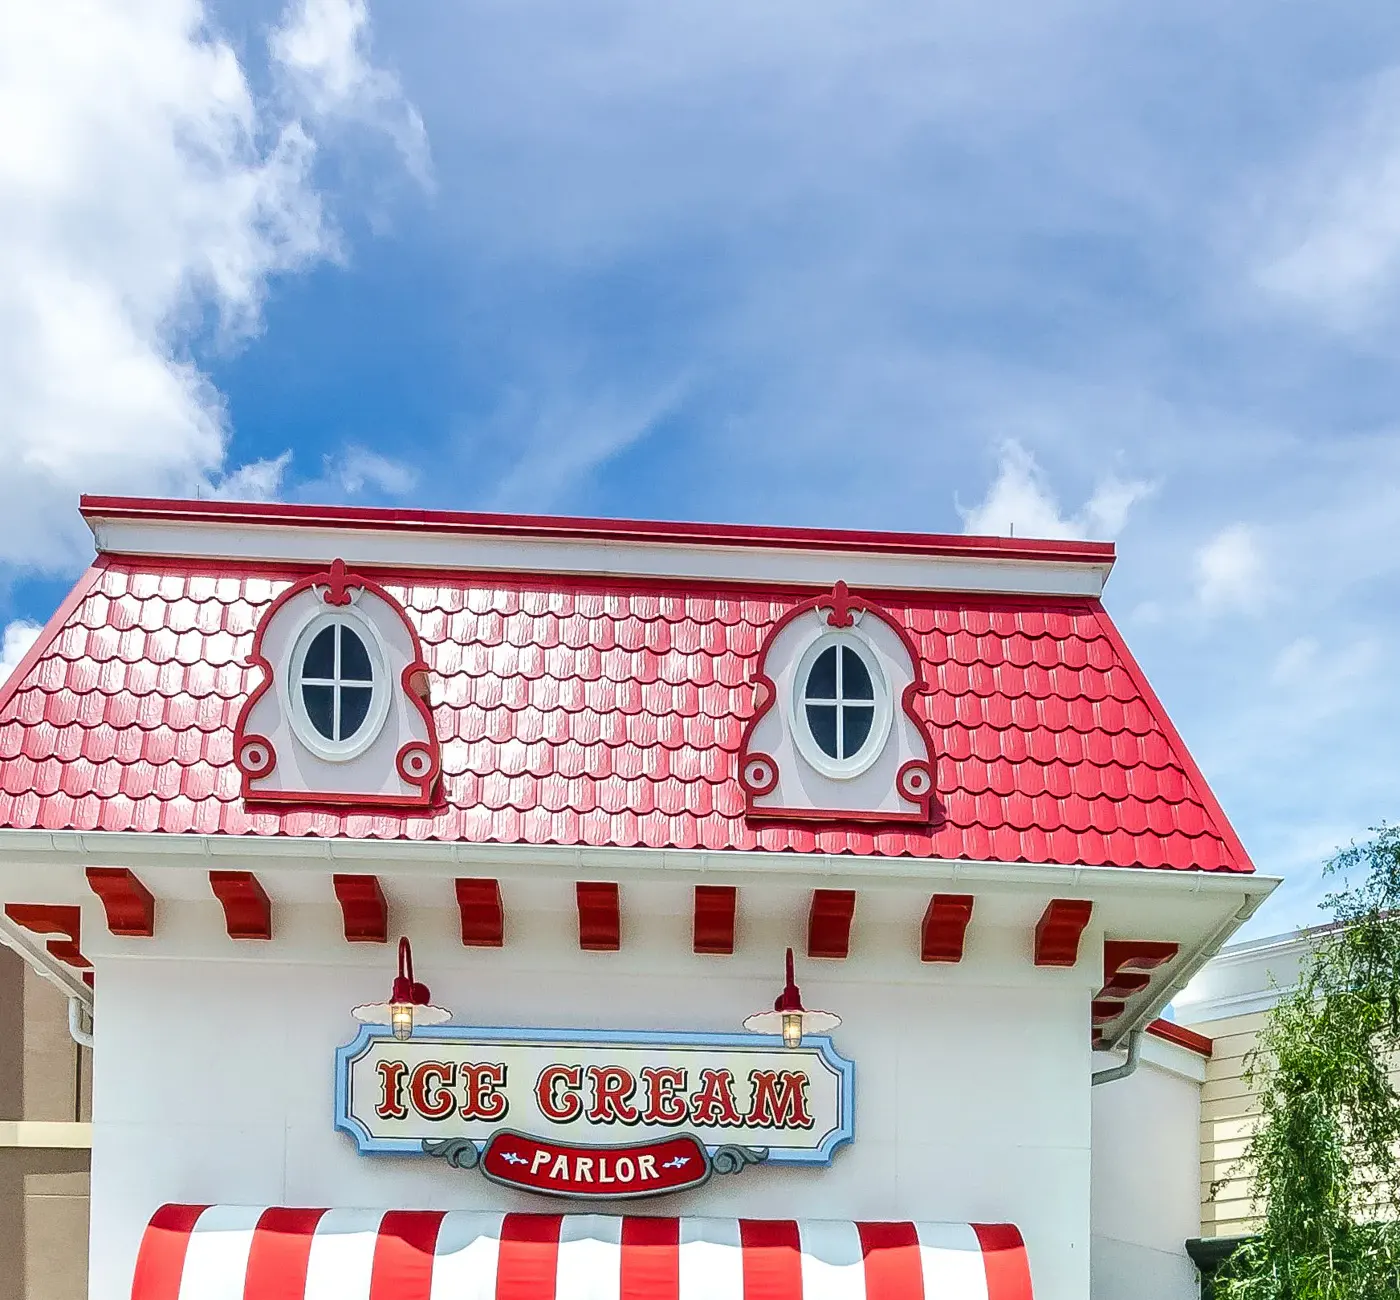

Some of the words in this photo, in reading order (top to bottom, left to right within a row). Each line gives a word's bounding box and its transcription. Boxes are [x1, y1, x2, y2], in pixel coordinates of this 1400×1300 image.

[375, 1060, 509, 1120] ICE
[533, 1063, 815, 1129] CREAM
[530, 1149, 660, 1184] PARLOR
